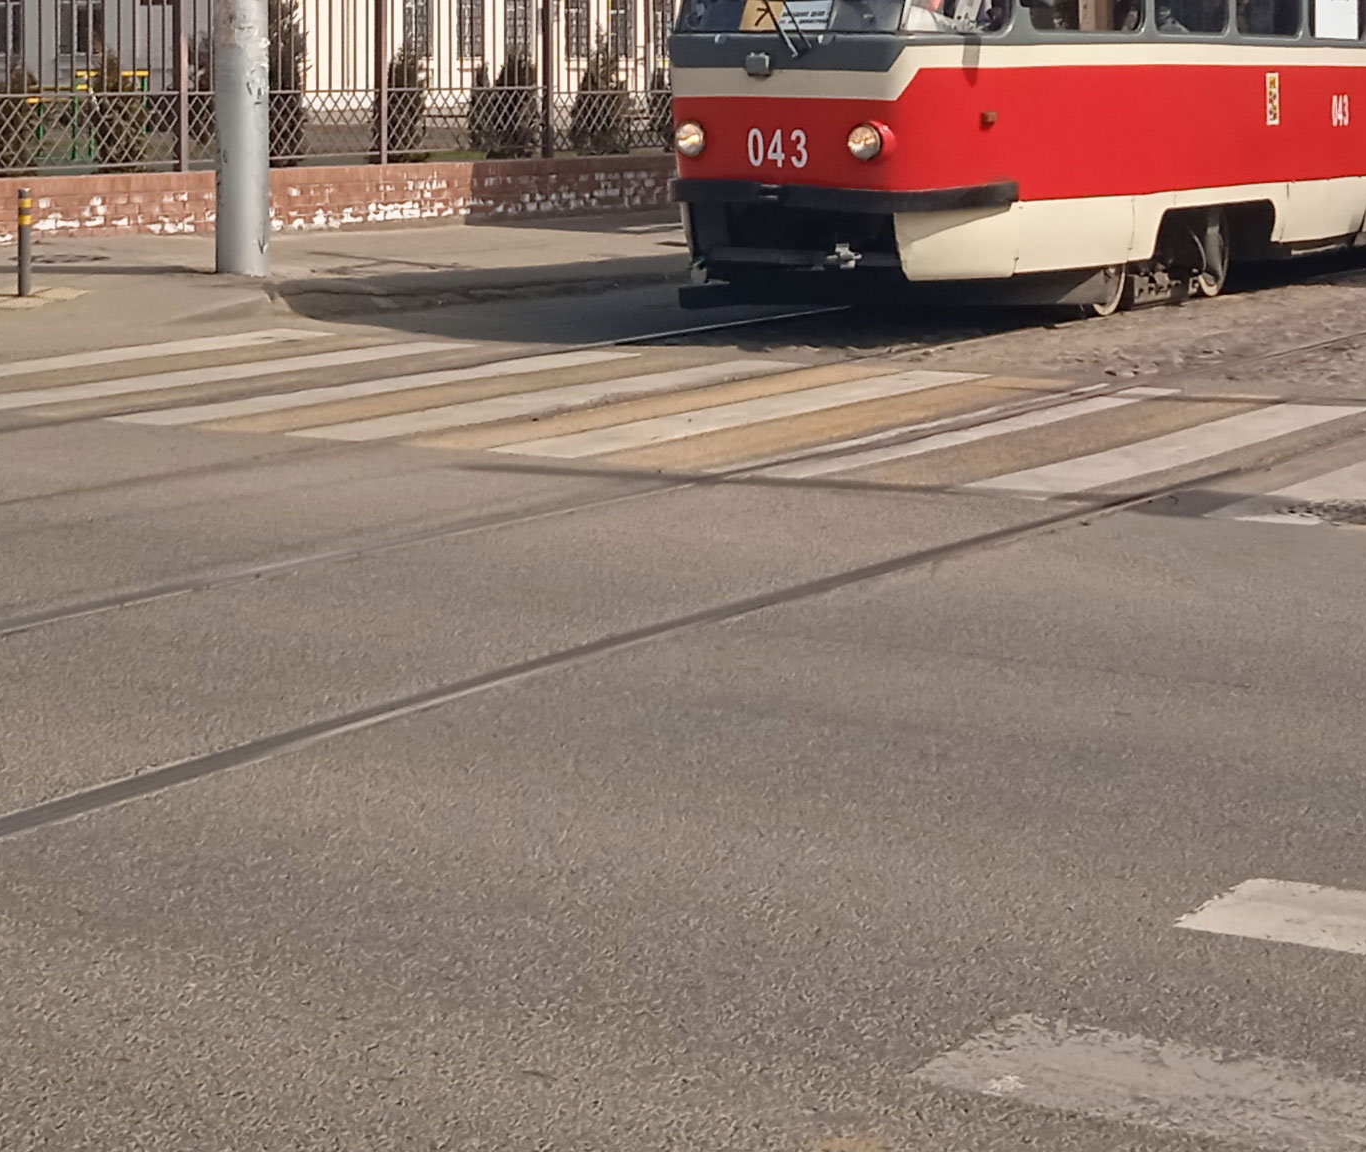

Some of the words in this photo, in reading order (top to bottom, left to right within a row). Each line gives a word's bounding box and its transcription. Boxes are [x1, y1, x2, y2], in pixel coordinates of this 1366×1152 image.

[754, 7, 771, 27] 7
[1332, 94, 1349, 127] 043
[747, 127, 808, 168] 043
